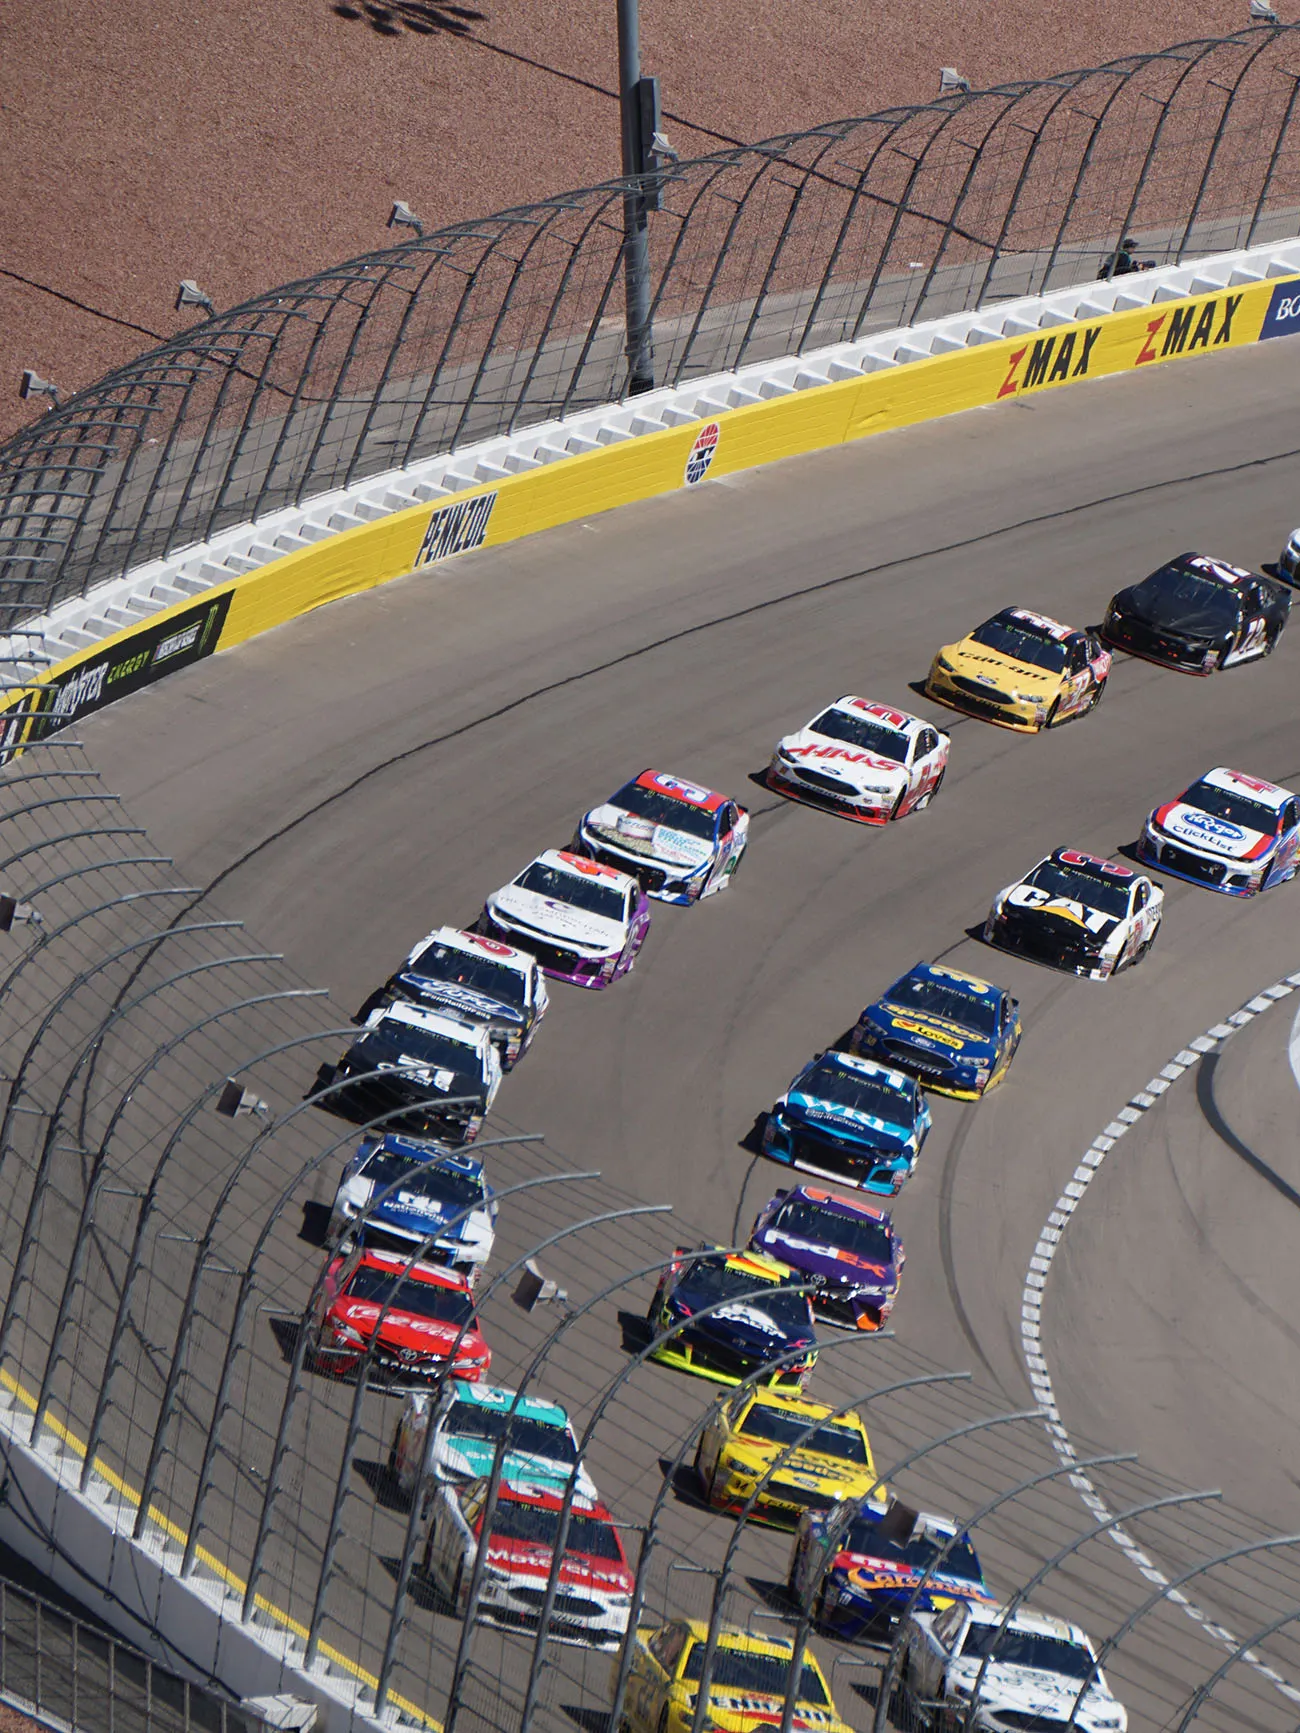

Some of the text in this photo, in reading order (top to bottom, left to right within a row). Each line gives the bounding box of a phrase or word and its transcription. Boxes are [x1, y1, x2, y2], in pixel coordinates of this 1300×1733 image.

[413, 491, 498, 568] PENNZOIL
[107, 650, 150, 683] ENERGY
[1008, 885, 1120, 934] CAT
[889, 1054, 942, 1075] FUSION
[765, 1229, 886, 1279] FedEx
